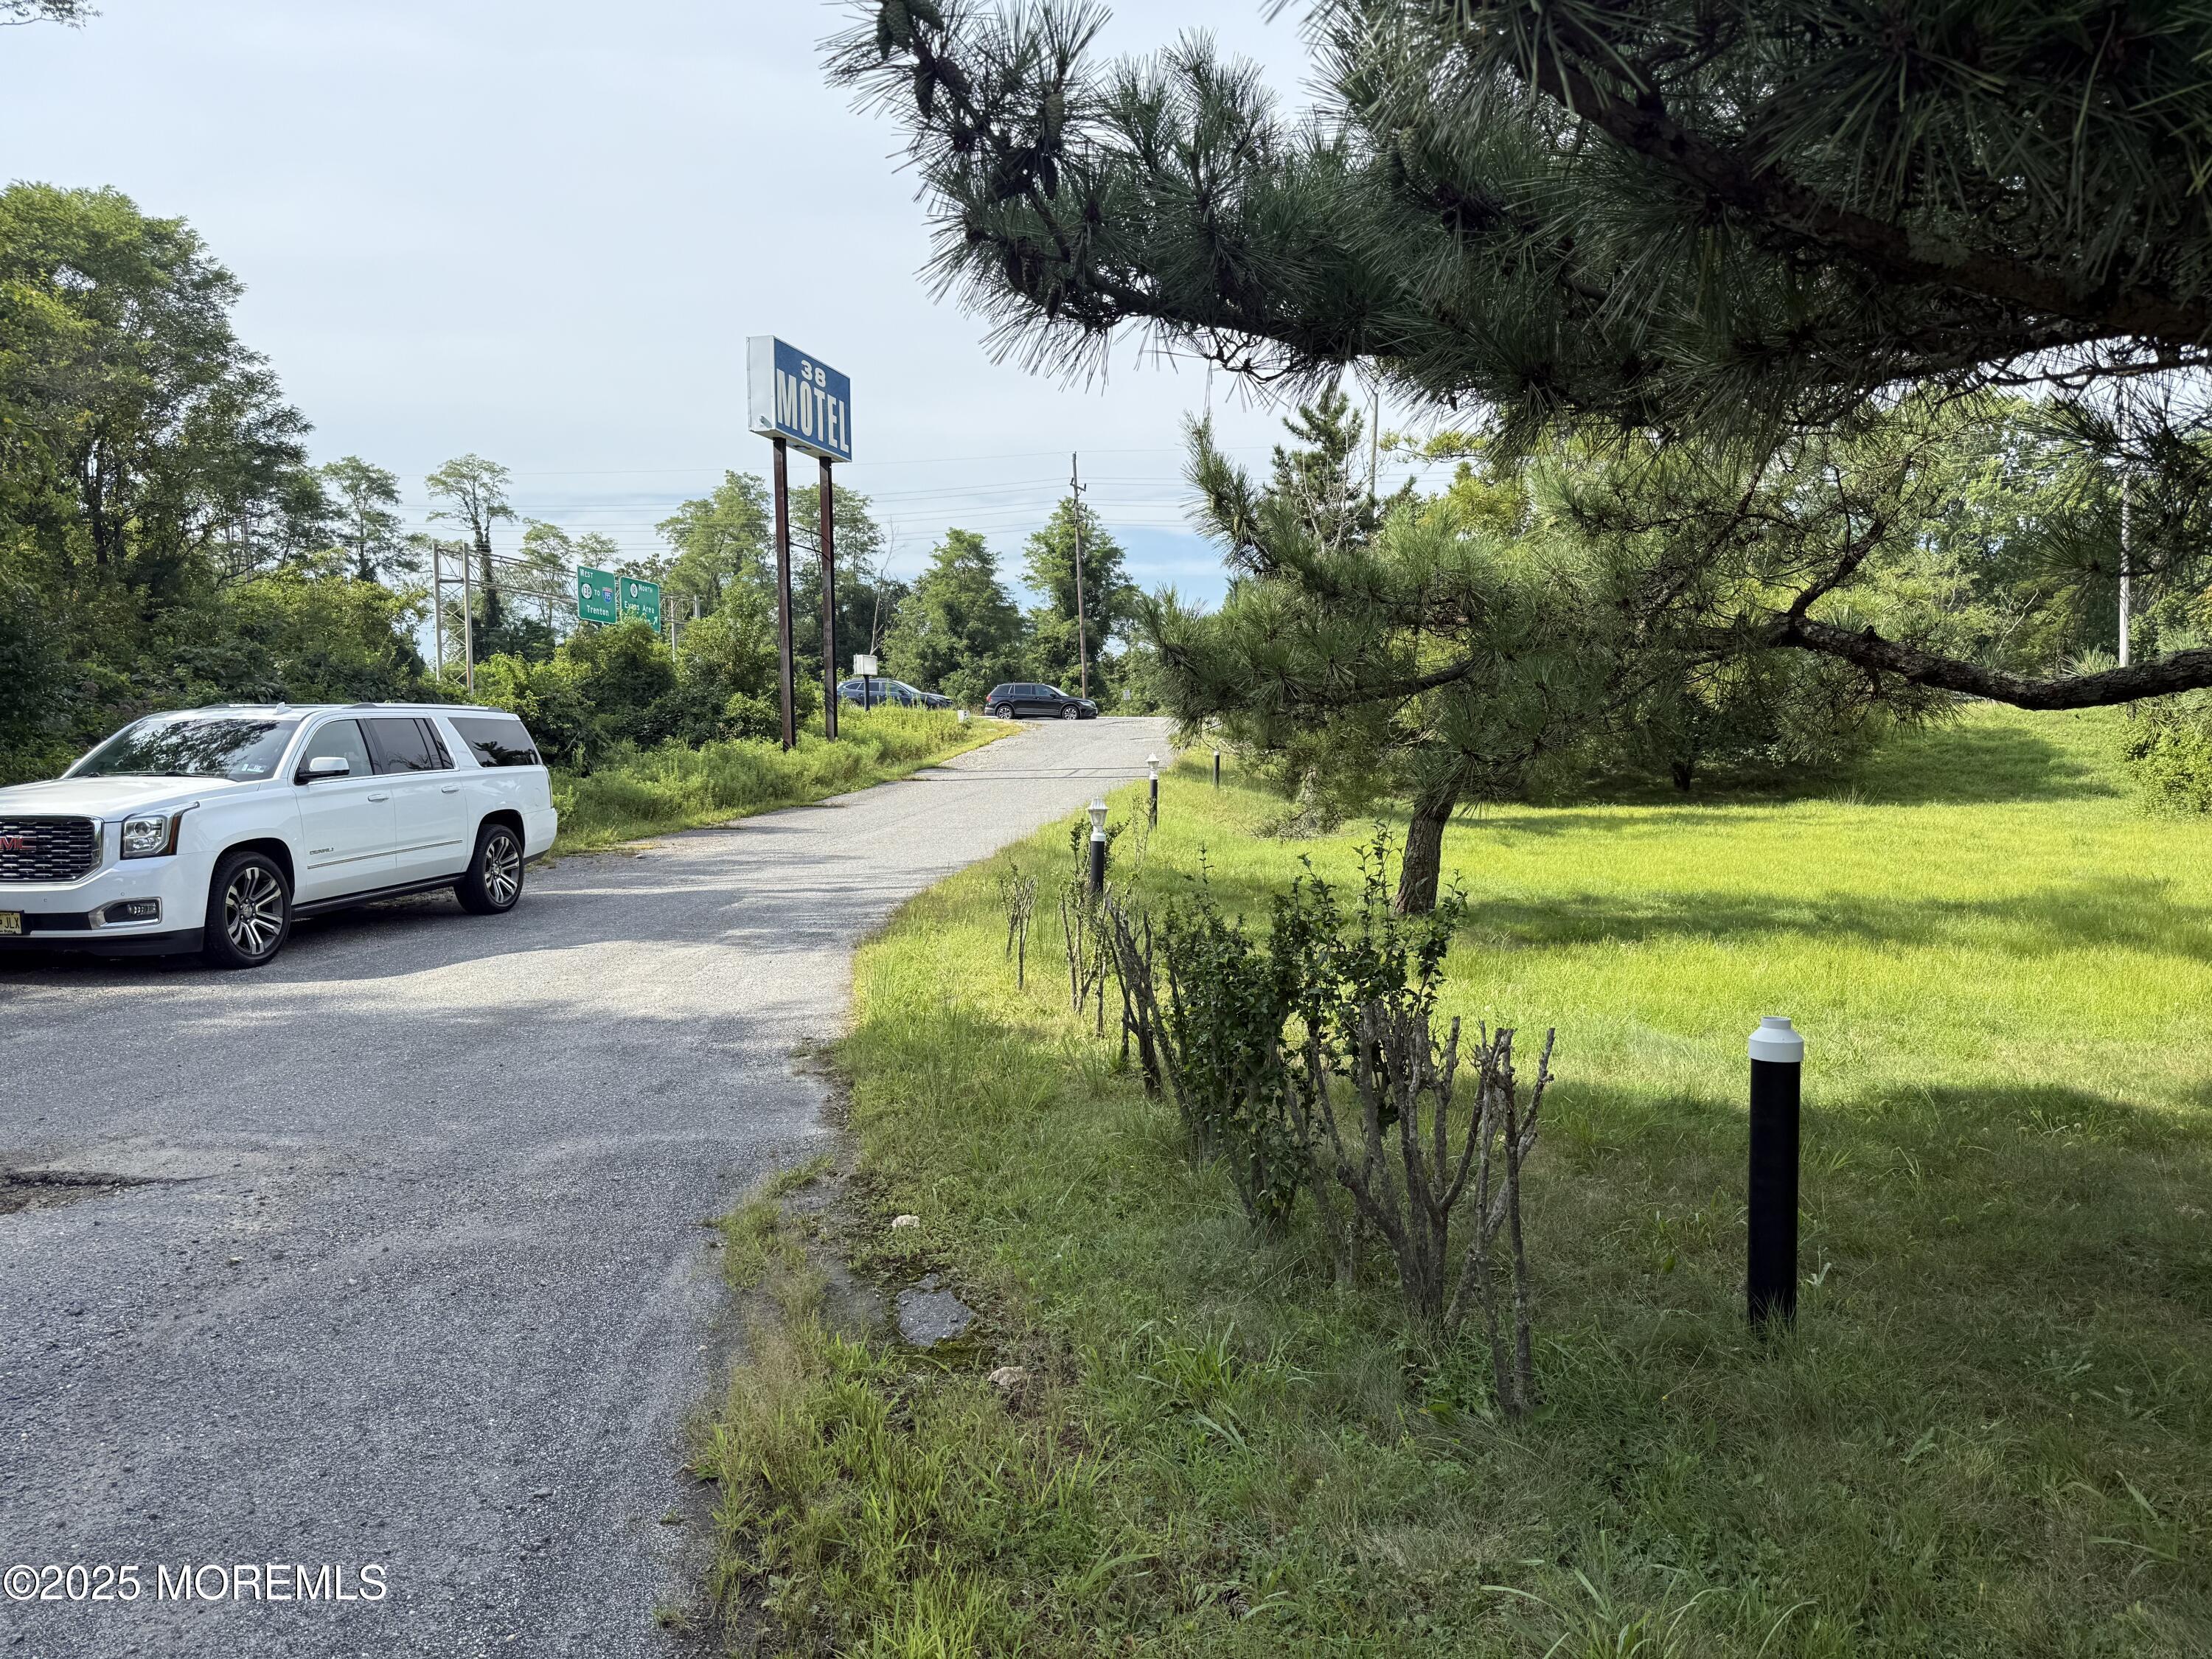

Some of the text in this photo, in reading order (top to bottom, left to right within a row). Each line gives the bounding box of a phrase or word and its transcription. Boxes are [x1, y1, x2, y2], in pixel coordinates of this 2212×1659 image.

[801, 359, 826, 388] 38
[776, 369, 849, 453] MOTEL
[580, 568, 594, 579] WEST
[639, 583, 653, 594] NORTH
[587, 605, 609, 616] Trenton
[642, 604, 655, 614] Area
[0, 835, 37, 851] MC
[4, 917, 20, 929] JLX
